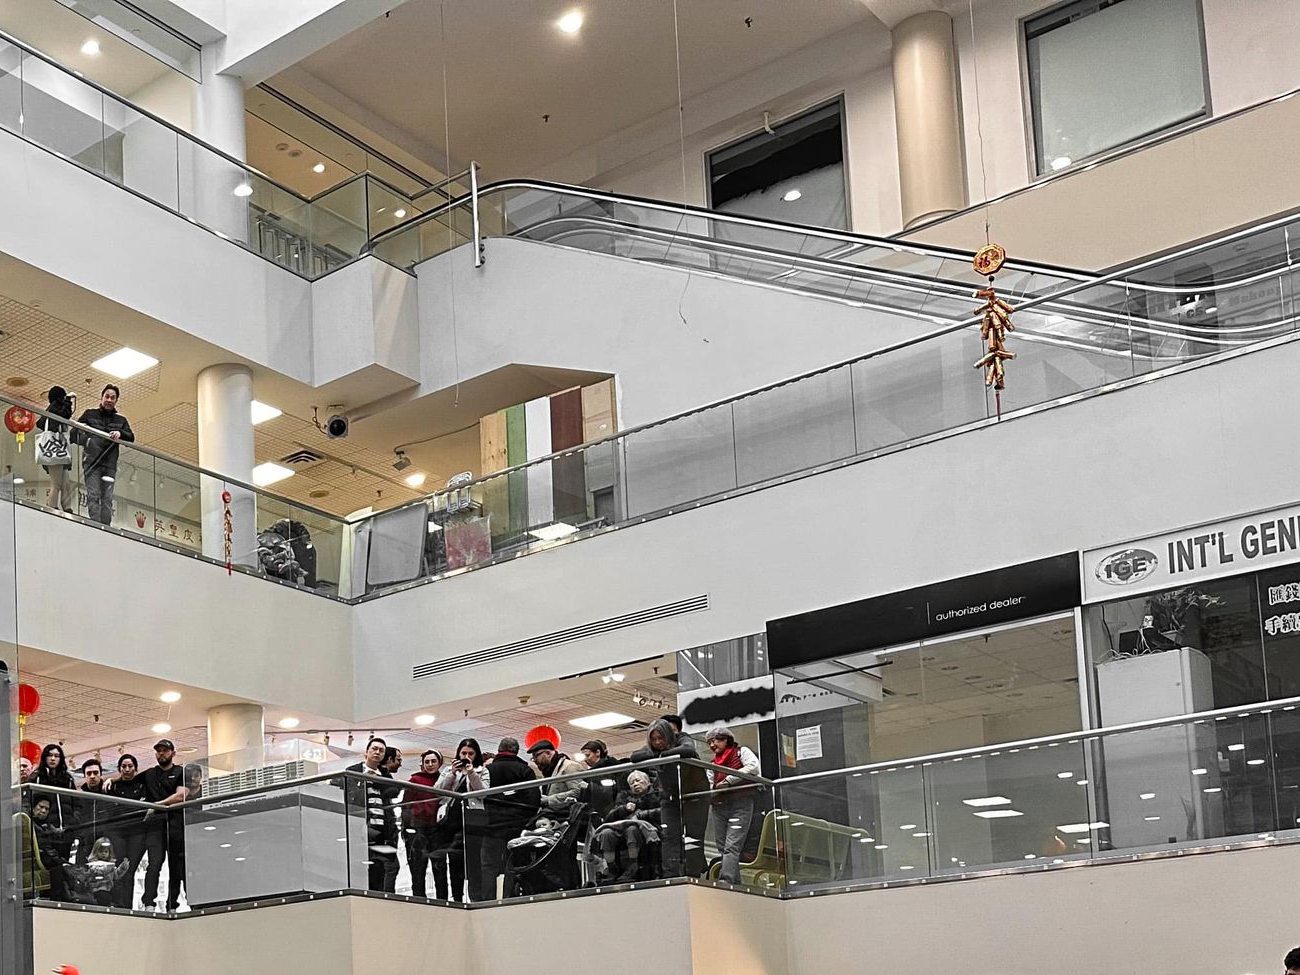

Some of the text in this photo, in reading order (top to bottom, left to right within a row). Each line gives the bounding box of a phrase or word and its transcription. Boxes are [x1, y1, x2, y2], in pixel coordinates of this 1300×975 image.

[1167, 515, 1300, 574] INT'L GEN
[1103, 557, 1147, 579] IGE
[935, 596, 1022, 622] authorized dealer
